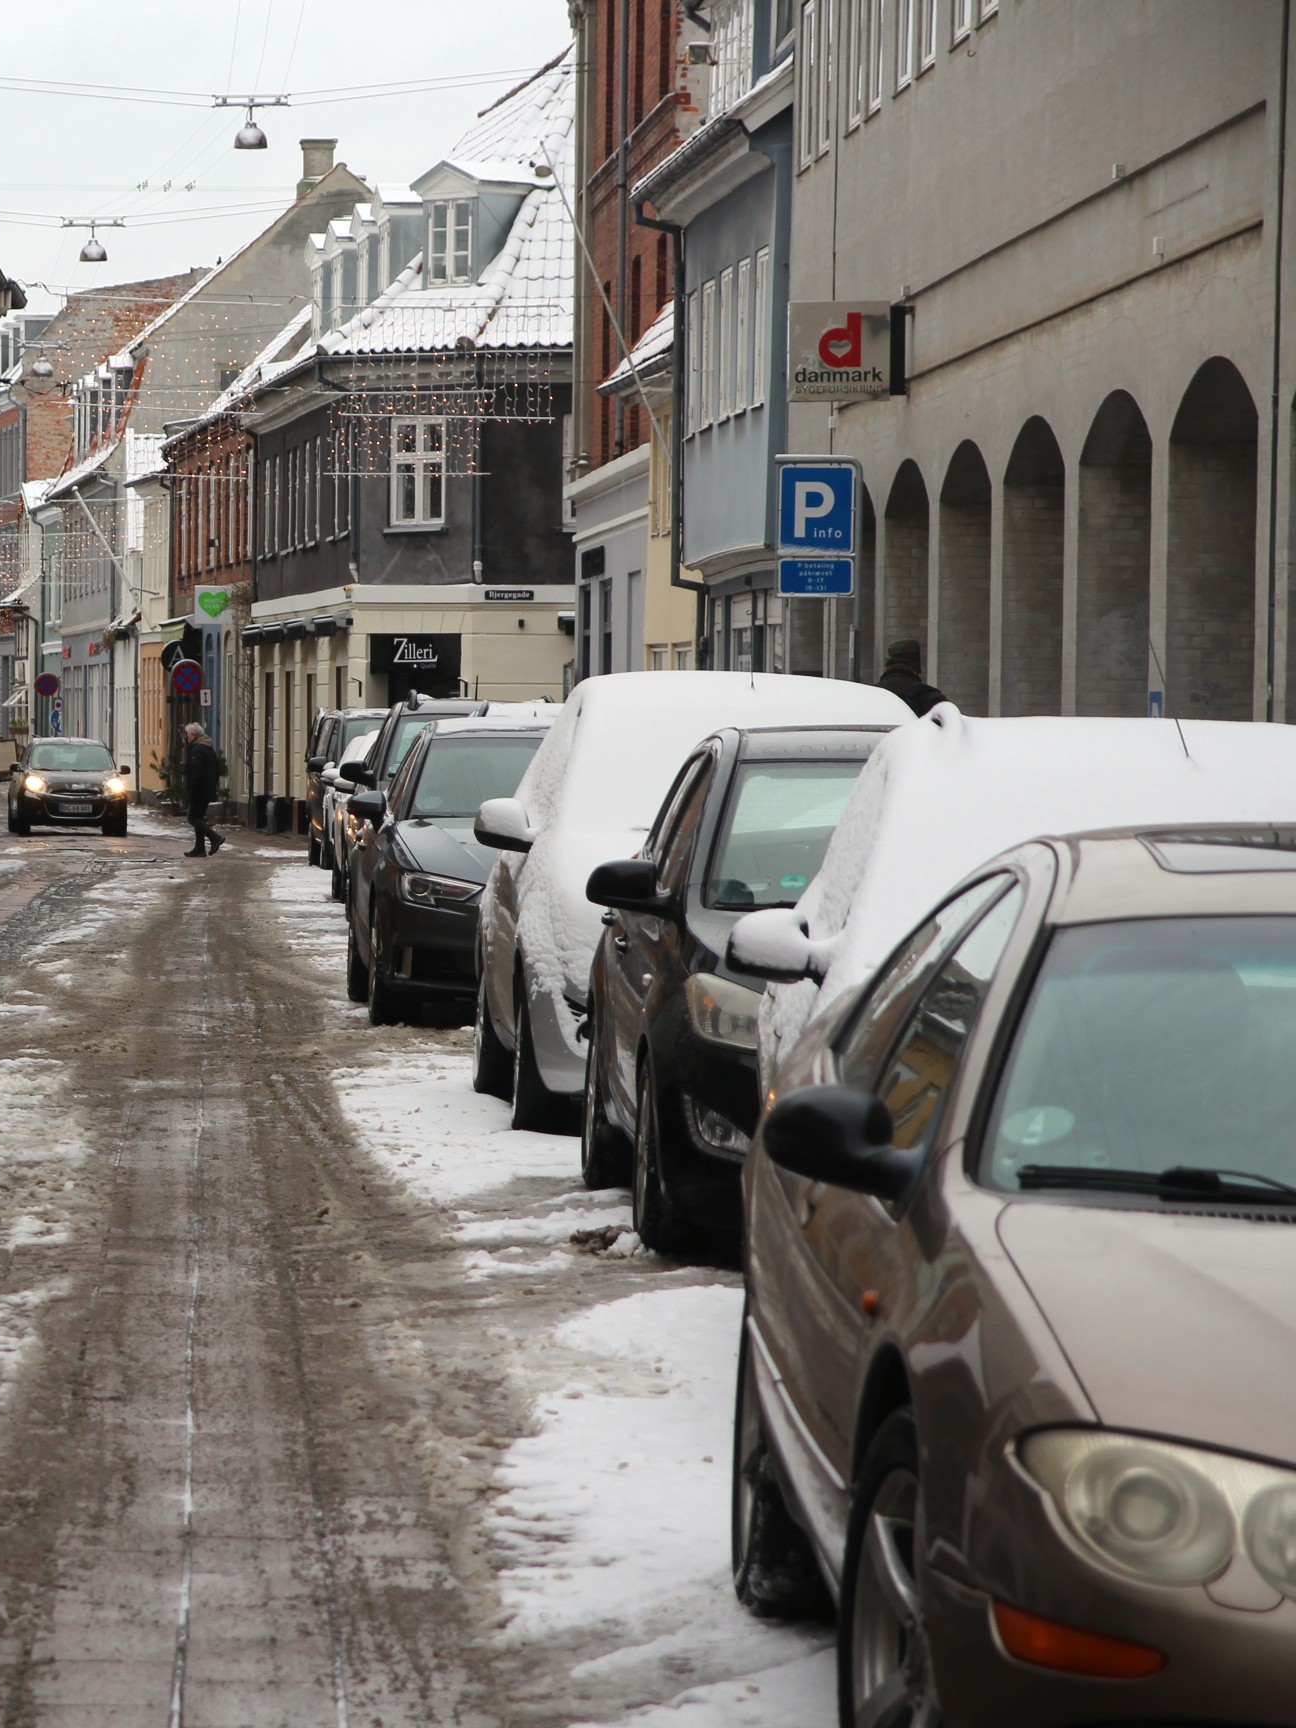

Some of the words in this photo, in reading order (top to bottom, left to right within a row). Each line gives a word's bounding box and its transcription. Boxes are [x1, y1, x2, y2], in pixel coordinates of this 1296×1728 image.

[794, 367, 883, 383] danmark
[795, 385, 884, 394] SYGEFORSIKRING
[794, 481, 835, 538] P
[813, 527, 842, 538] info
[489, 590, 530, 599] Bjergegade
[393, 638, 438, 662] Zilleri
